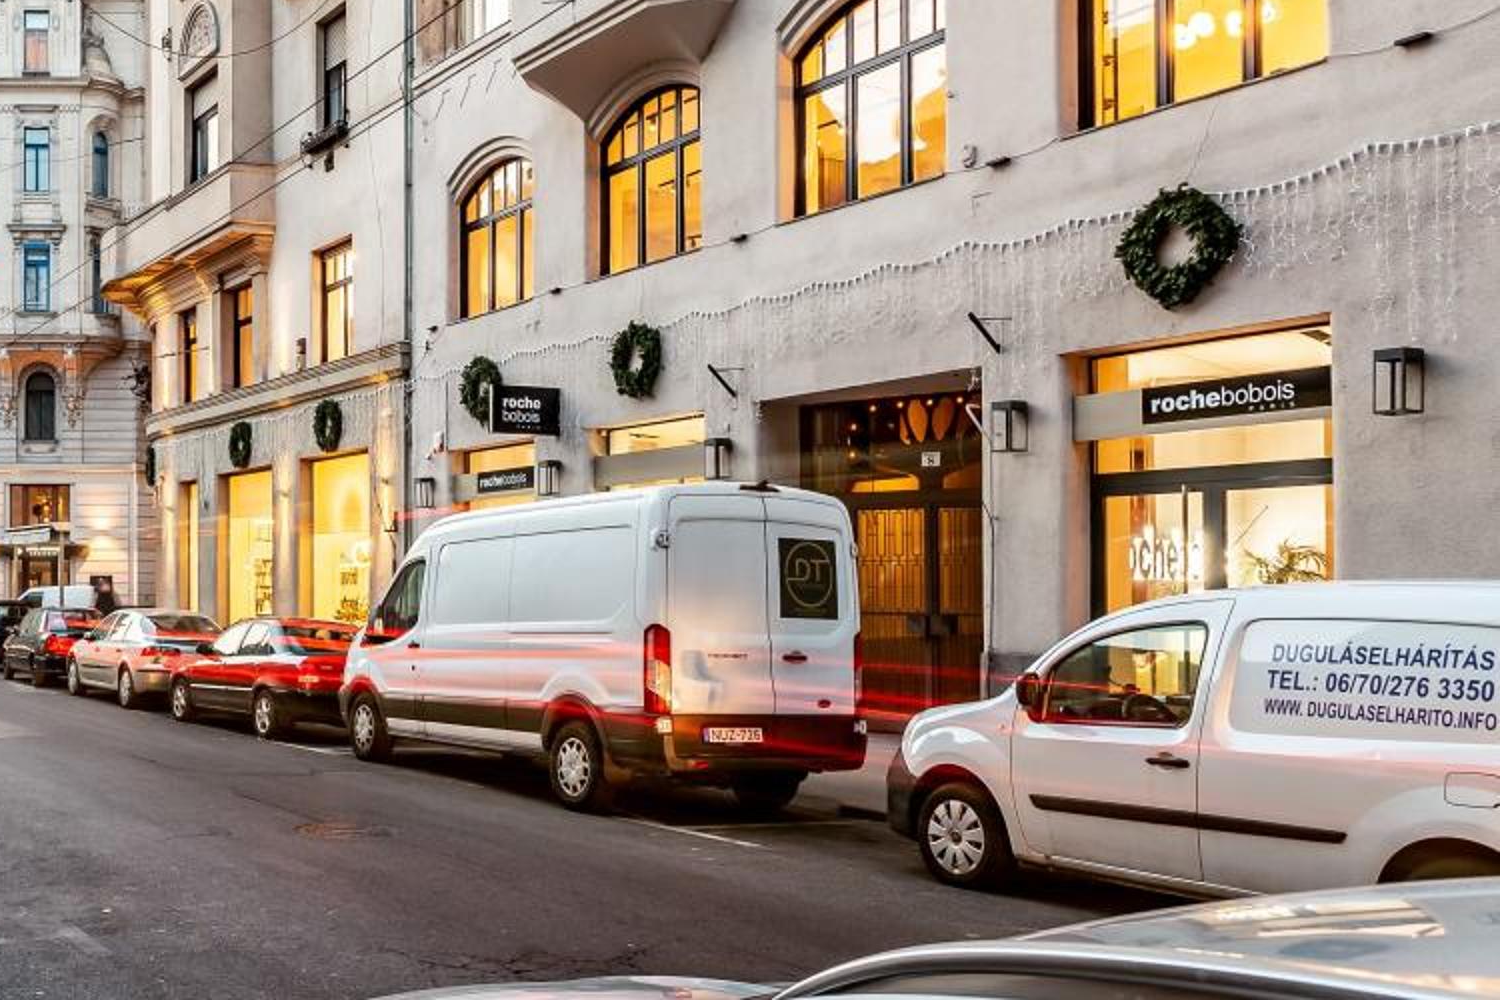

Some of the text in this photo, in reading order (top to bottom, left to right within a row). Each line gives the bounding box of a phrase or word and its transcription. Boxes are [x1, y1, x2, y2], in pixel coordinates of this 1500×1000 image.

[502, 396, 541, 409] roche
[1150, 379, 1296, 415] rochebobois
[1271, 641, 1496, 671] DUGULÁSELHÁRÍTÁS
[1267, 669, 1496, 702] TEL.: 06/70/276 3350
[1264, 698, 1498, 731] WWW. DUGULASELHARITO.INFO
